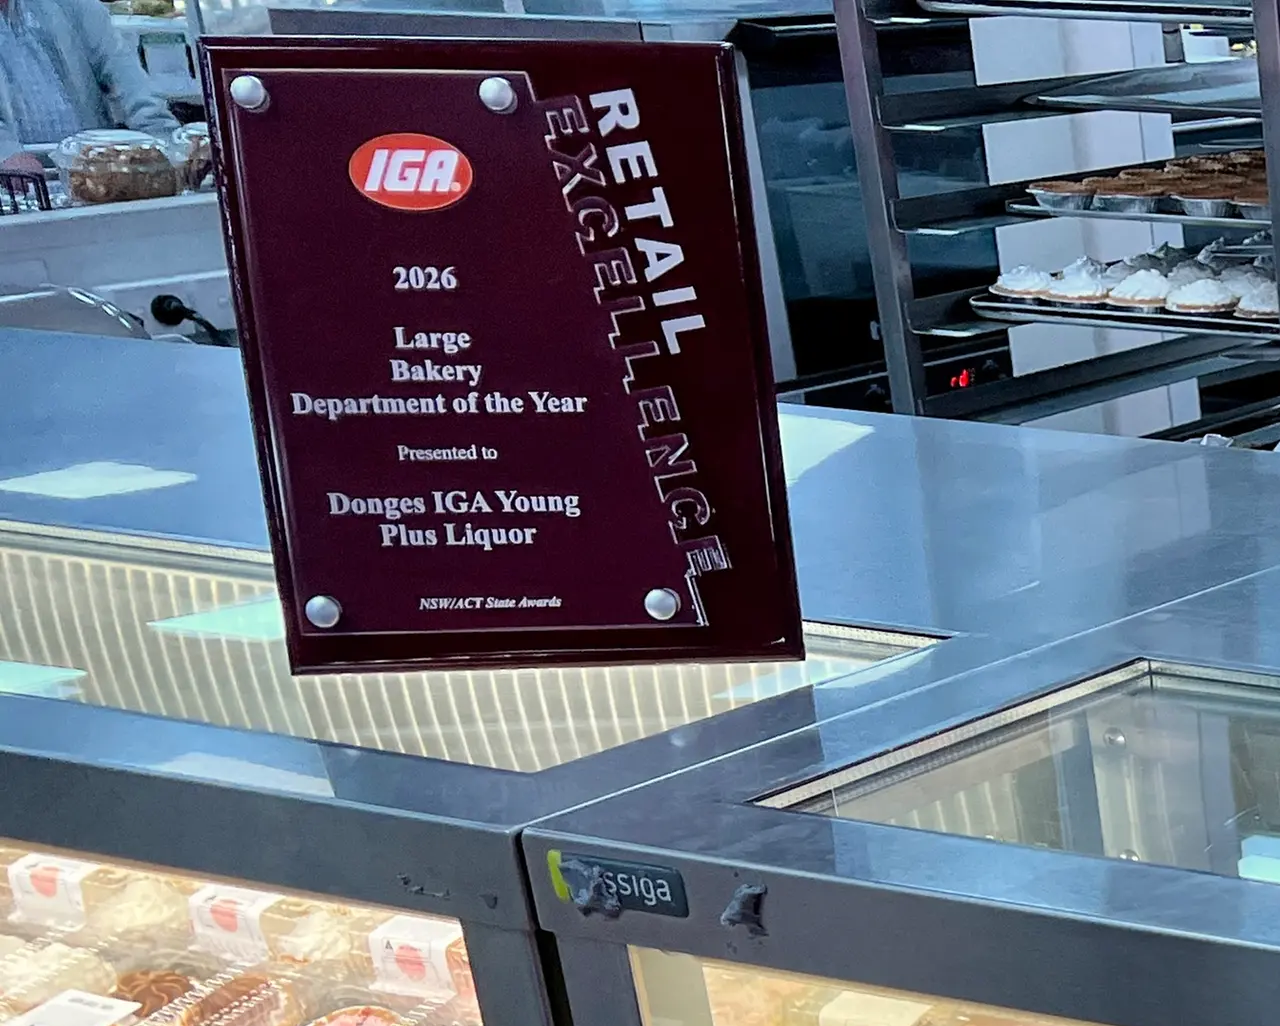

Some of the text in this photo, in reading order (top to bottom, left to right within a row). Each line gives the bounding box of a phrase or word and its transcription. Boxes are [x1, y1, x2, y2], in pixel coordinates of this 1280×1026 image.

[365, 148, 457, 193] IGA
[589, 87, 706, 355] RETAIL
[393, 266, 458, 291] 2026
[395, 327, 471, 354] Large
[544, 95, 732, 576] EXCELLENCE
[389, 360, 482, 388] Bakery
[291, 391, 588, 420] Department of the Year
[397, 445, 498, 462] Presented to
[328, 492, 581, 521] Donges IGA Young
[381, 524, 537, 551] Plus Liquor
[419, 595, 562, 612] NSW/ACT State Awards
[603, 871, 672, 907] ssiga
